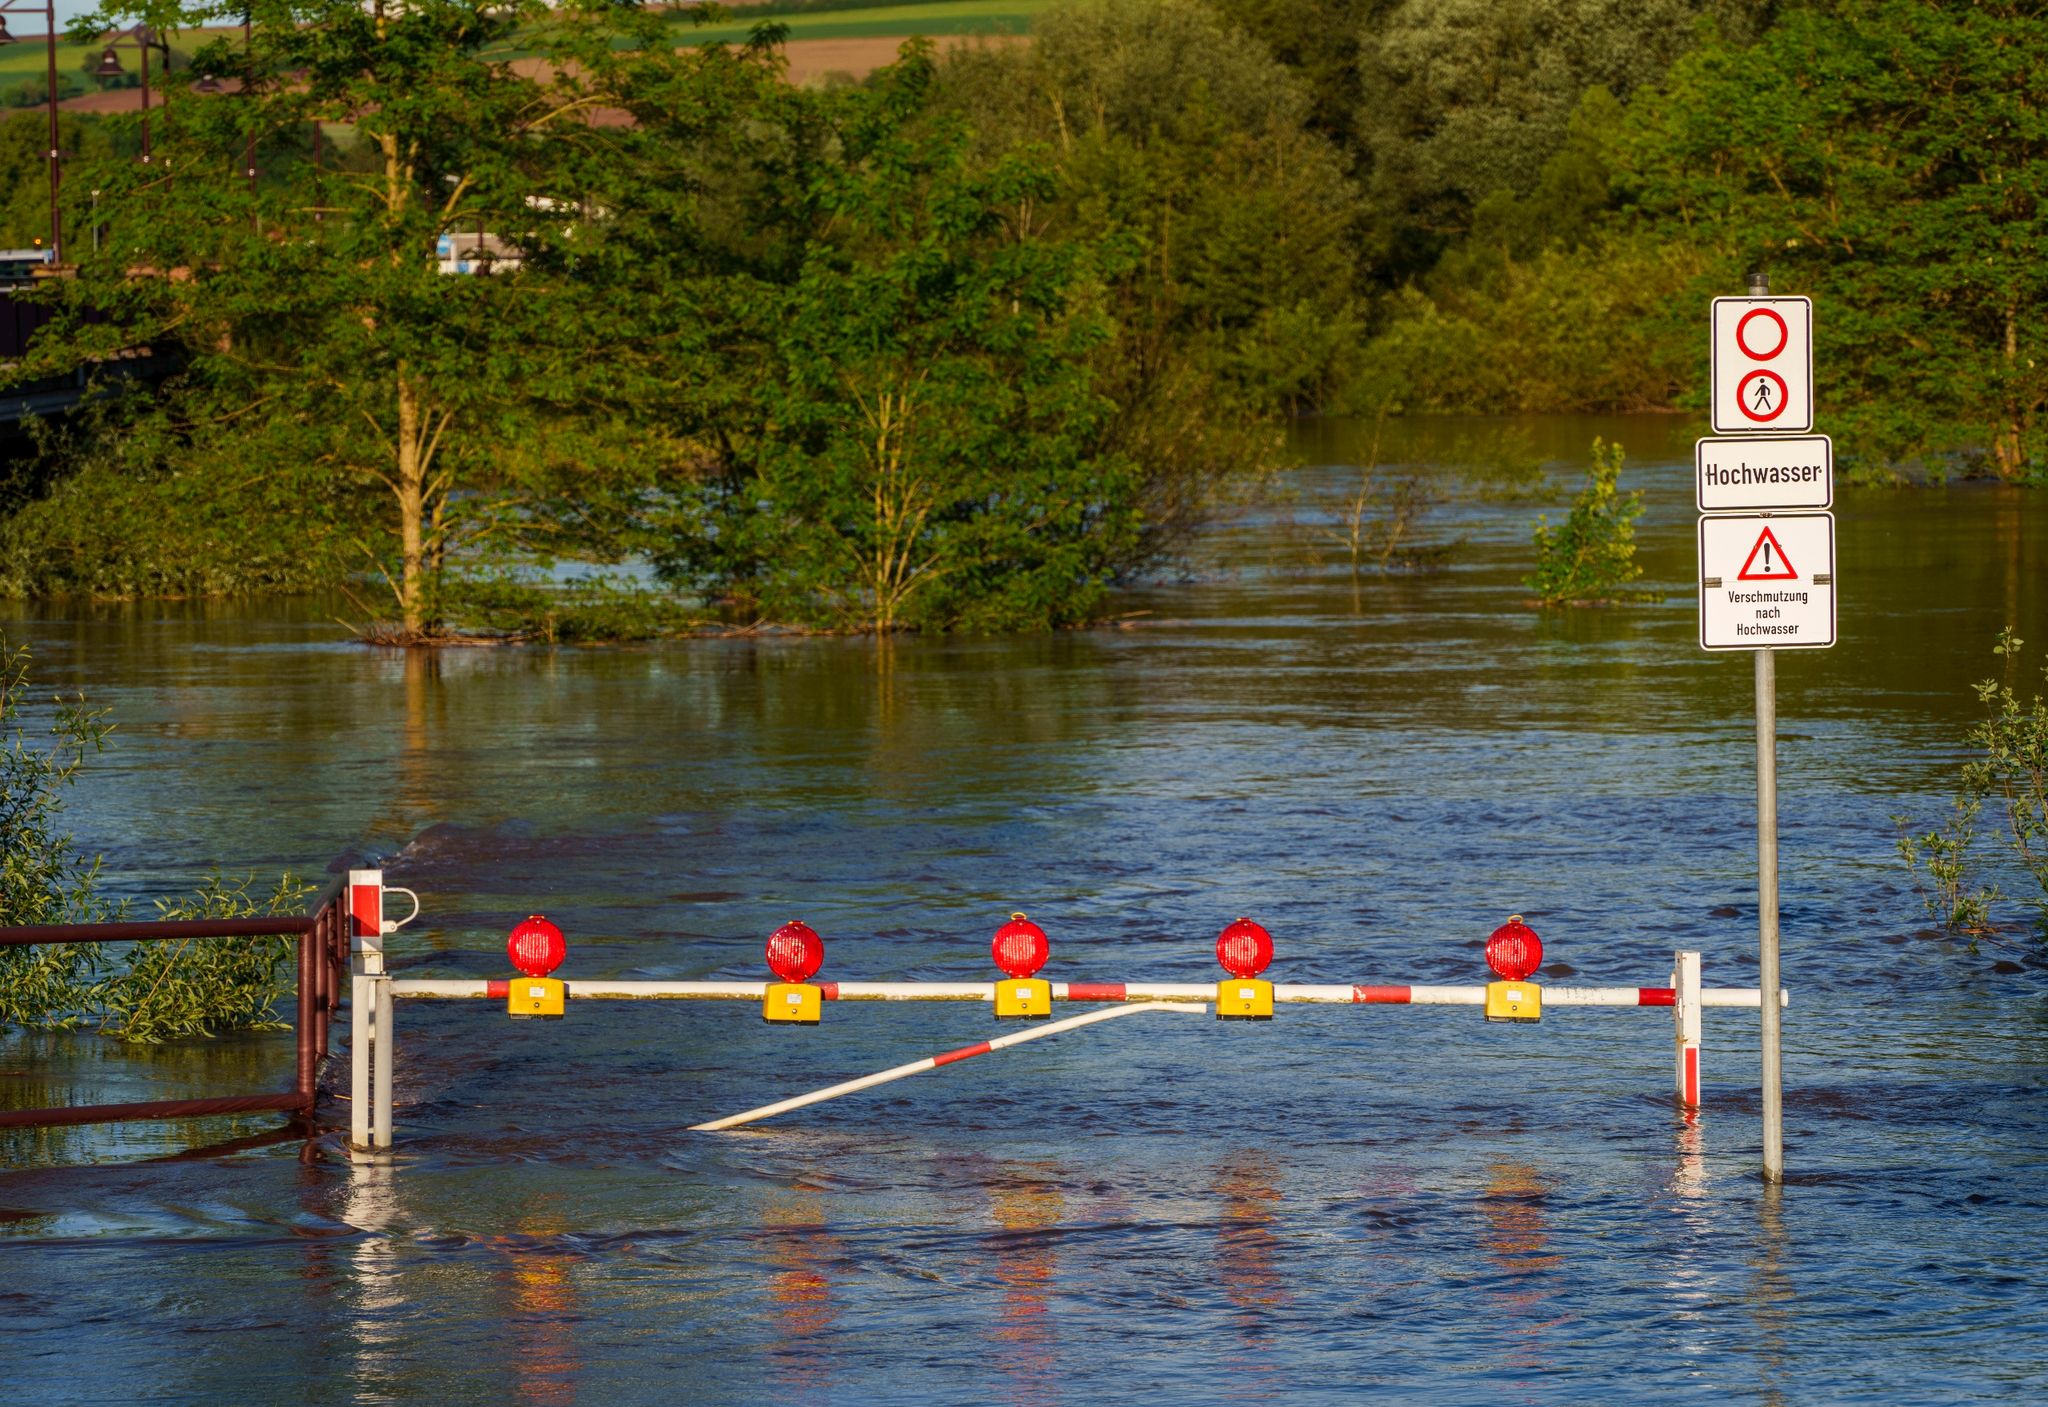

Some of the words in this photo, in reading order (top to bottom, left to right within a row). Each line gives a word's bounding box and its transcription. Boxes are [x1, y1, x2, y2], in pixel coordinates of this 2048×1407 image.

[1706, 463, 1821, 486] Hochwasser
[1728, 590, 1808, 605] Verschmutzung
[1755, 606, 1781, 619] nach
[1736, 623, 1799, 636] Hochwasser
